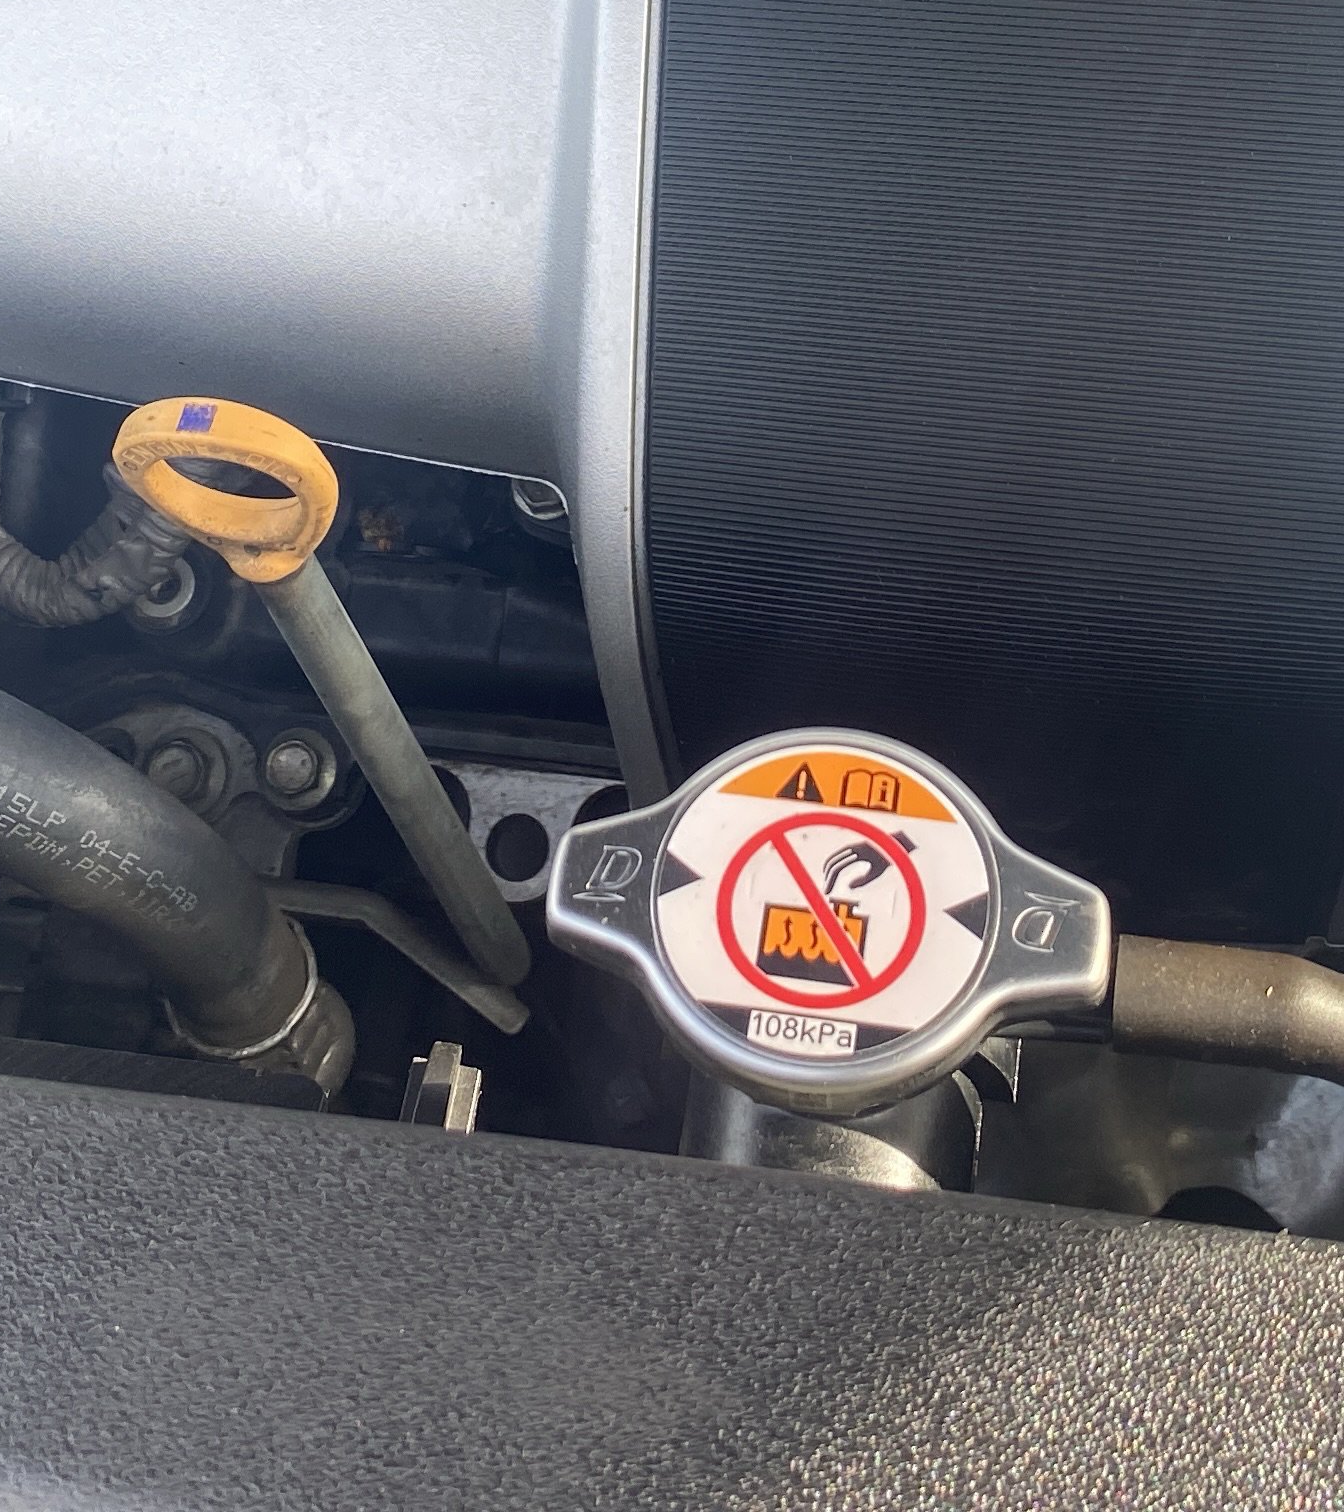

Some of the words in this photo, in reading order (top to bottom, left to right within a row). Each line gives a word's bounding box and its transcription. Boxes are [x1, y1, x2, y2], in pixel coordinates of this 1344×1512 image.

[122, 439, 209, 467] ENGINE
[79, 829, 199, 912] 04-E-C-AB
[750, 1012, 854, 1051] 108kPa
